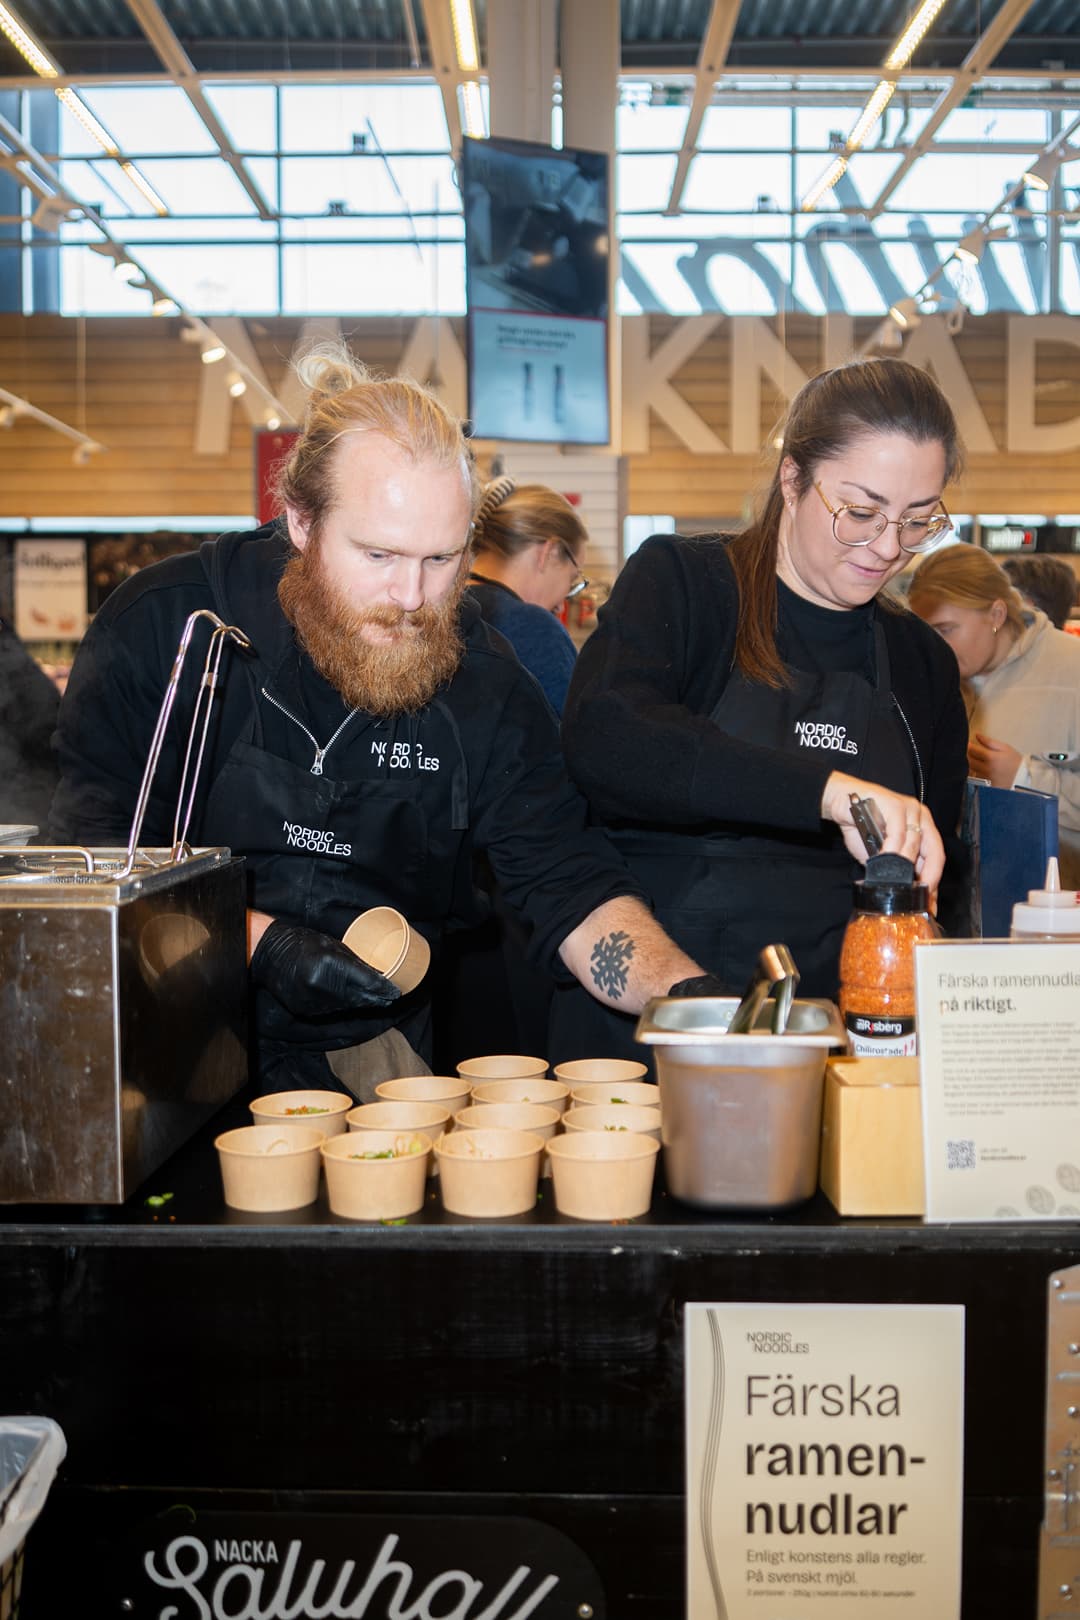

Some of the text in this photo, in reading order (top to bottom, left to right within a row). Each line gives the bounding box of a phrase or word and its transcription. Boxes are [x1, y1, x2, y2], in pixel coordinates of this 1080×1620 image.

[794, 721, 847, 739] NORDIC
[799, 734, 859, 755] NOODLES
[283, 820, 335, 842] NORDIC
[287, 832, 352, 856] NOODLES
[938, 973, 989, 988] Färska
[940, 996, 1017, 1014] på riktigt.
[746, 1332, 792, 1343] NORDIC
[754, 1343, 810, 1353] NOODLES
[746, 1374, 900, 1417] Färska
[746, 1441, 926, 1476] ramen-
[746, 1493, 908, 1535] nudlar
[214, 1539, 279, 1563] NACKA
[746, 1550, 927, 1566] Enligt konstens alla regler.
[746, 1569, 764, 1583] På
[767, 1571, 821, 1583] svenskt
